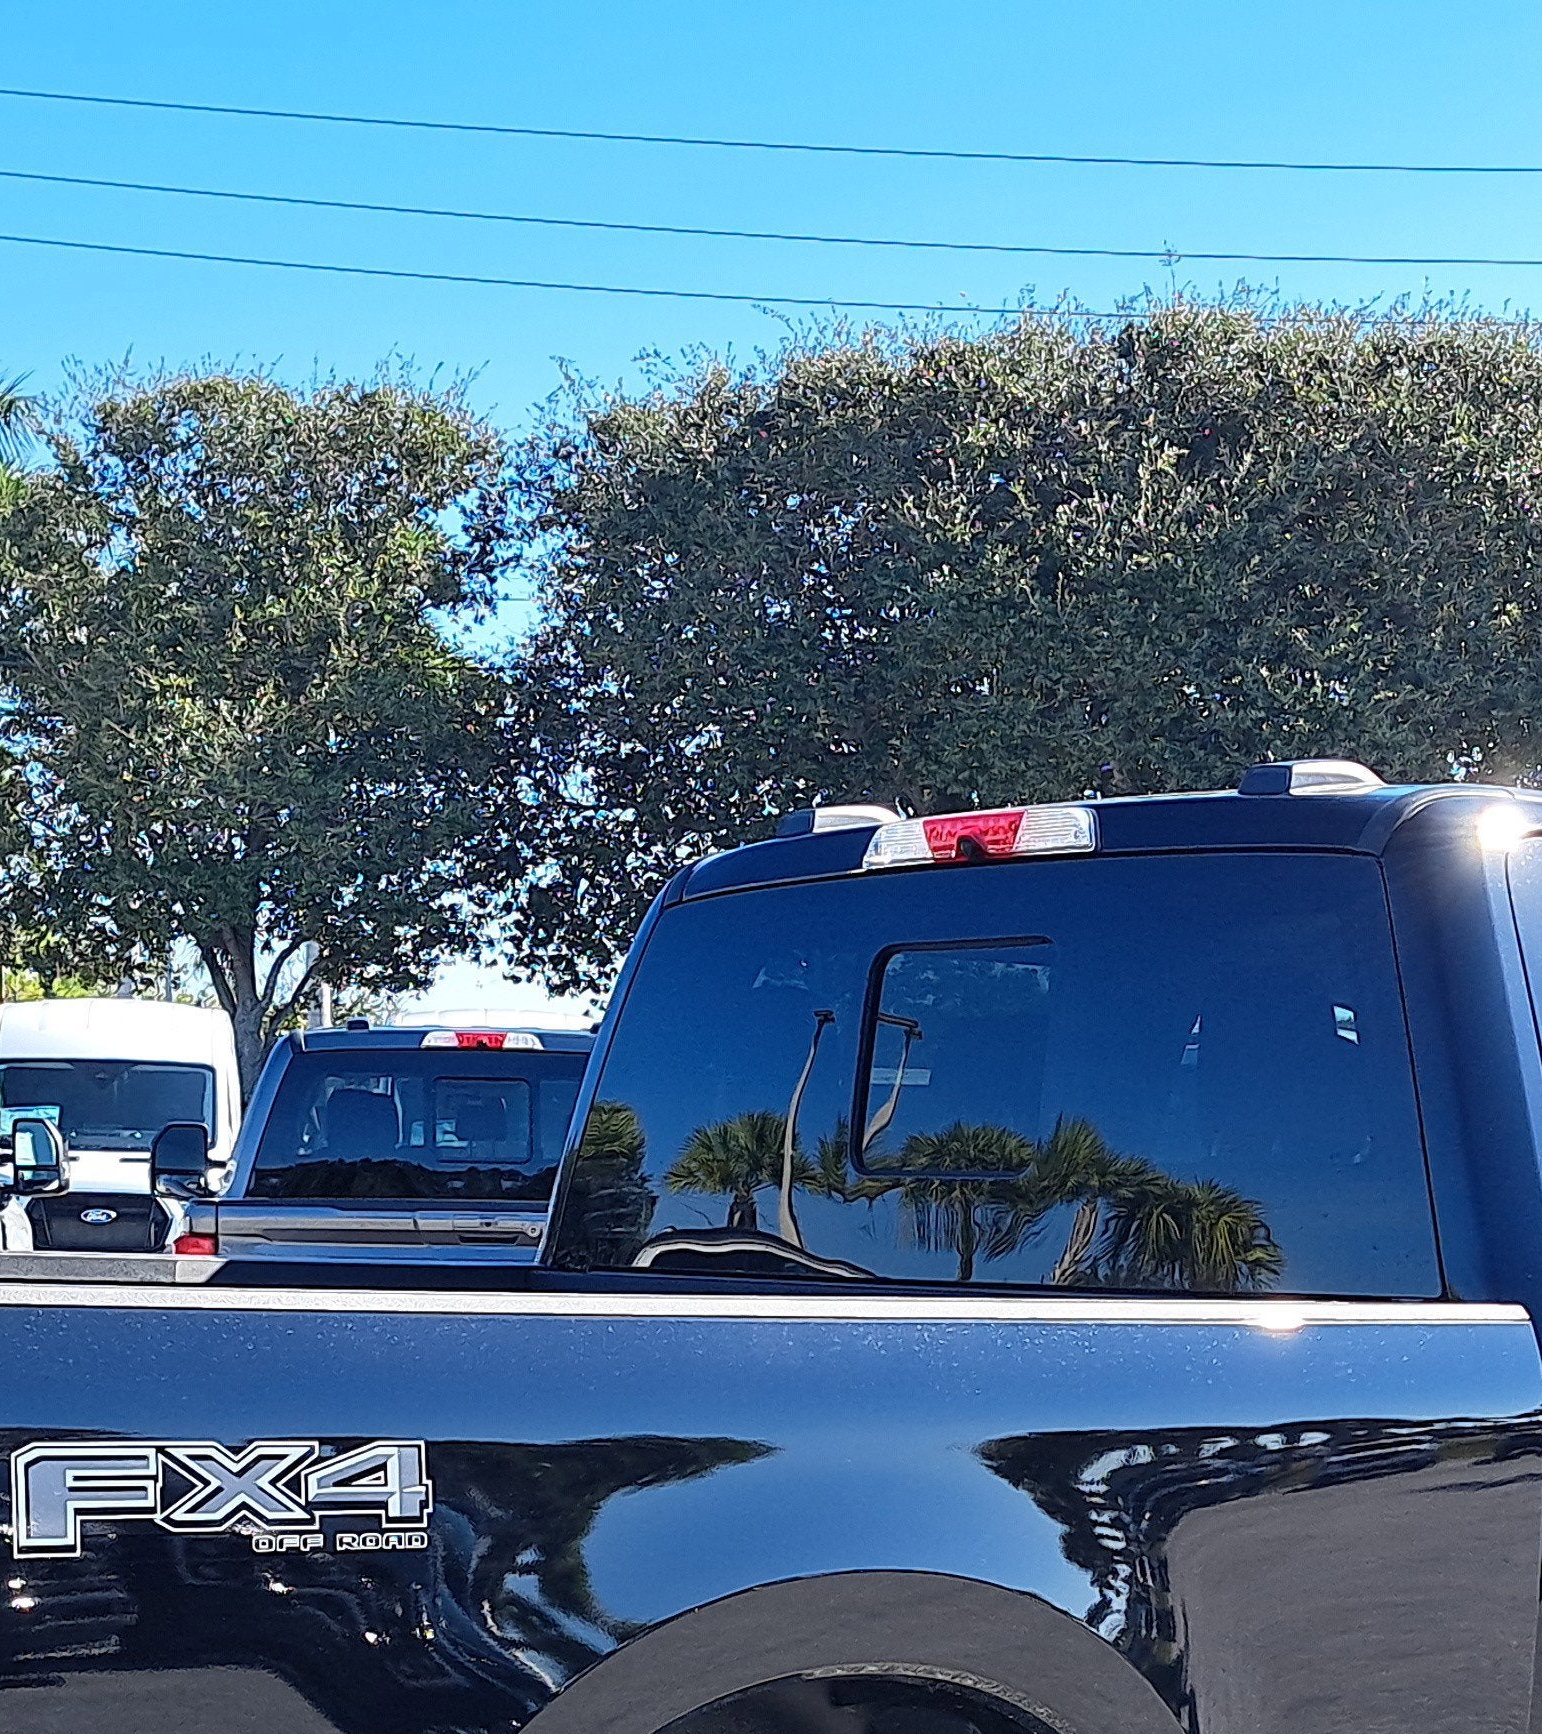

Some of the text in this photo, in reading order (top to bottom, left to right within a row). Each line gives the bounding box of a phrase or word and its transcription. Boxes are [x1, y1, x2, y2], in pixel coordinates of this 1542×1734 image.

[10, 1440, 433, 1560] FX4
[251, 1532, 429, 1553] OFF ROAD
